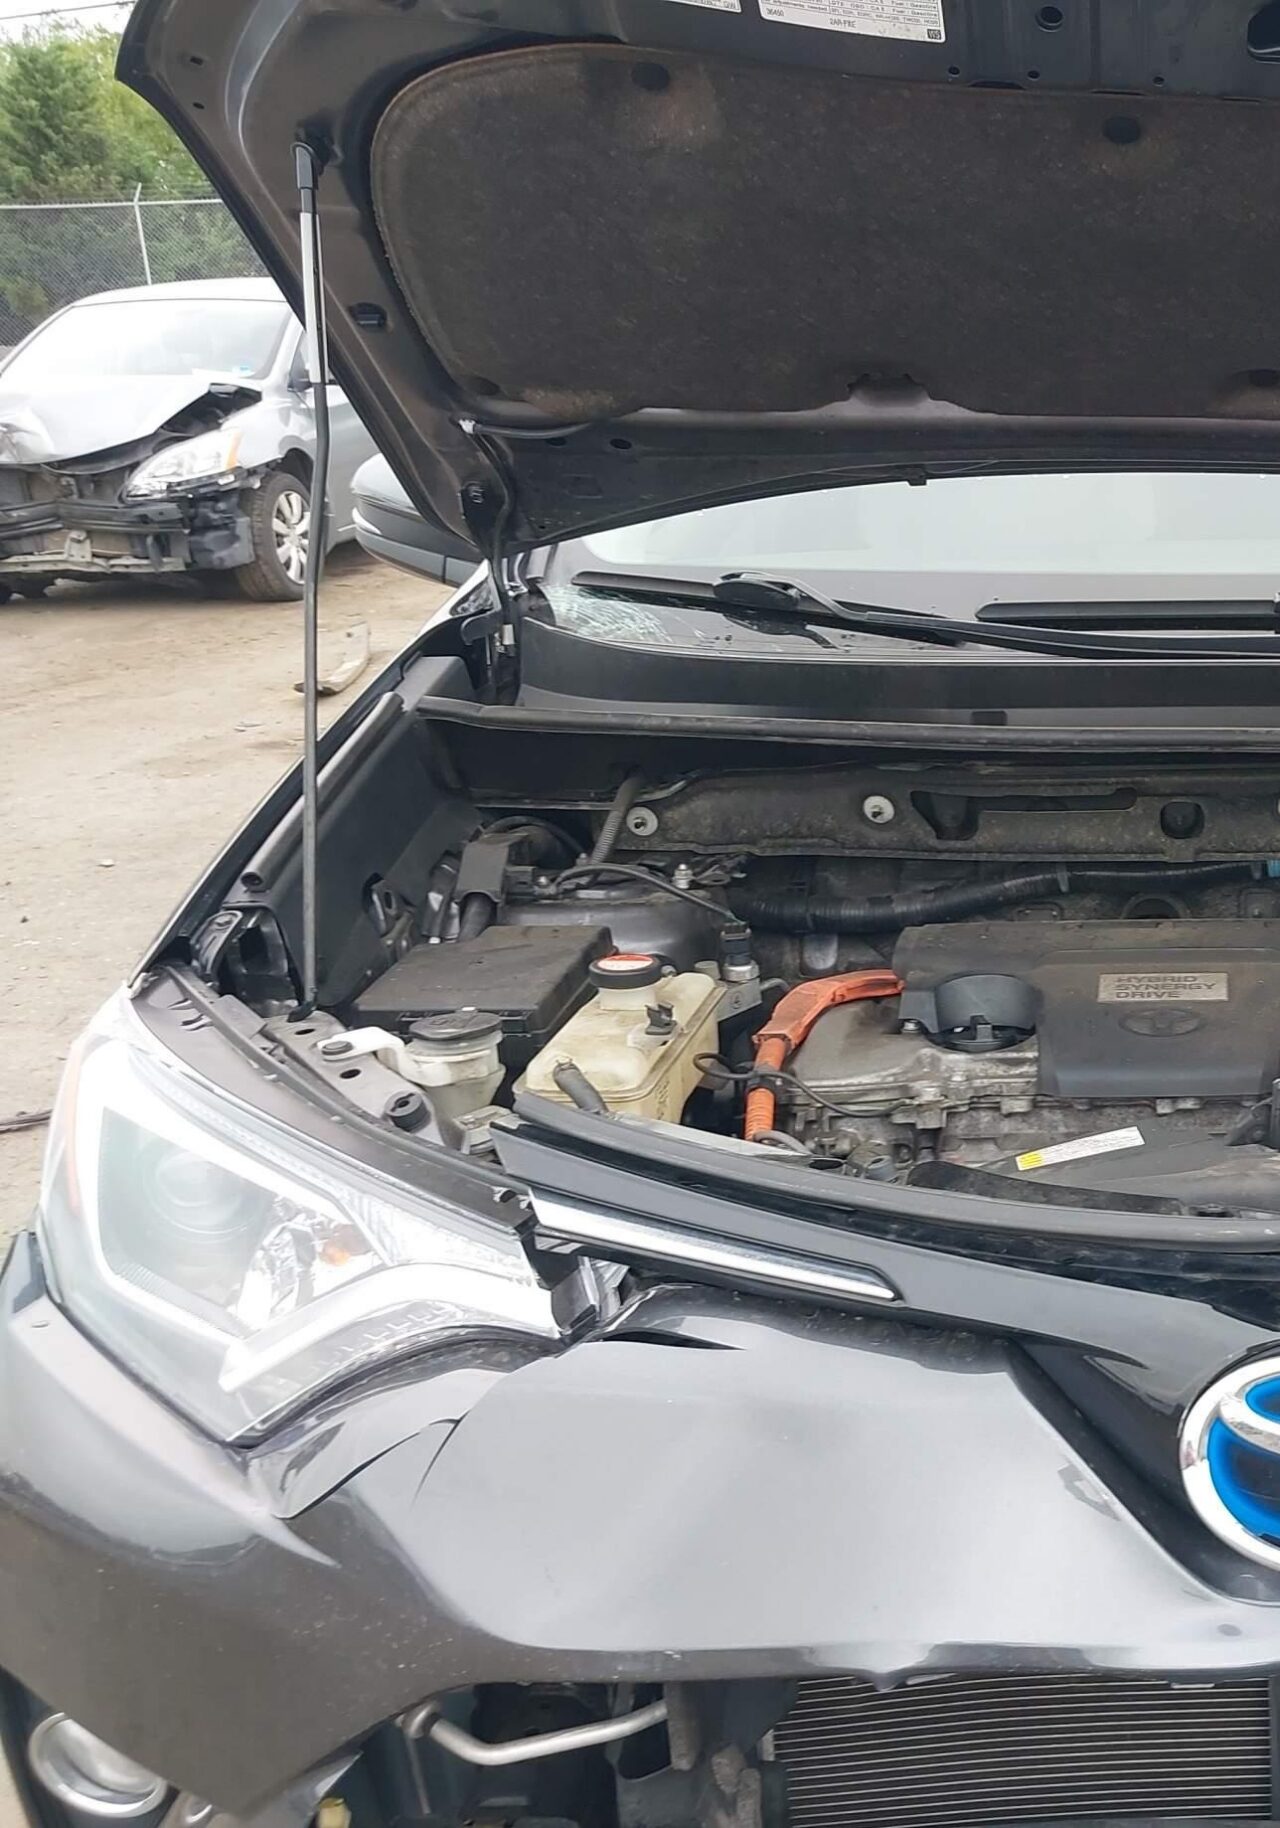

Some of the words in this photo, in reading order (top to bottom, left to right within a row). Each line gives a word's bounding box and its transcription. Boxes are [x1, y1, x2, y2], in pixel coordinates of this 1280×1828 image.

[1117, 975, 1198, 983] HYBRID
[1113, 983, 1217, 991] SYNERGY
[1115, 991, 1182, 999] DRIVE
